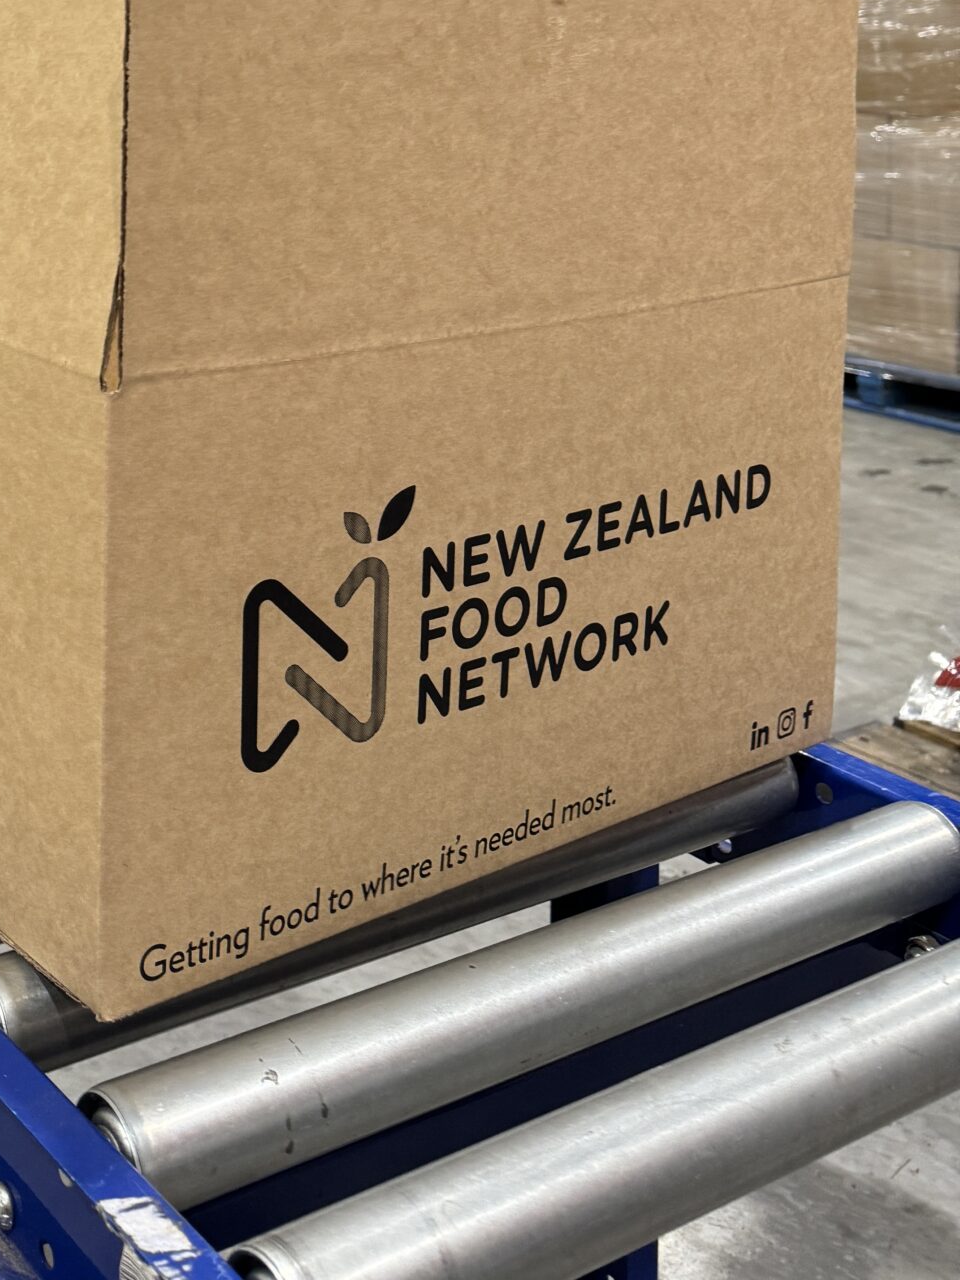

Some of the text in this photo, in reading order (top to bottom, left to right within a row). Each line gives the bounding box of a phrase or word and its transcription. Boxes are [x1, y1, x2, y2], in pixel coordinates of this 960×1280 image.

[420, 462, 772, 599] NEW ZEALAND
[417, 599, 671, 725] NETWORK
[419, 575, 568, 663] FOOD
[139, 784, 617, 983] Getting food to where it’s needed most.
